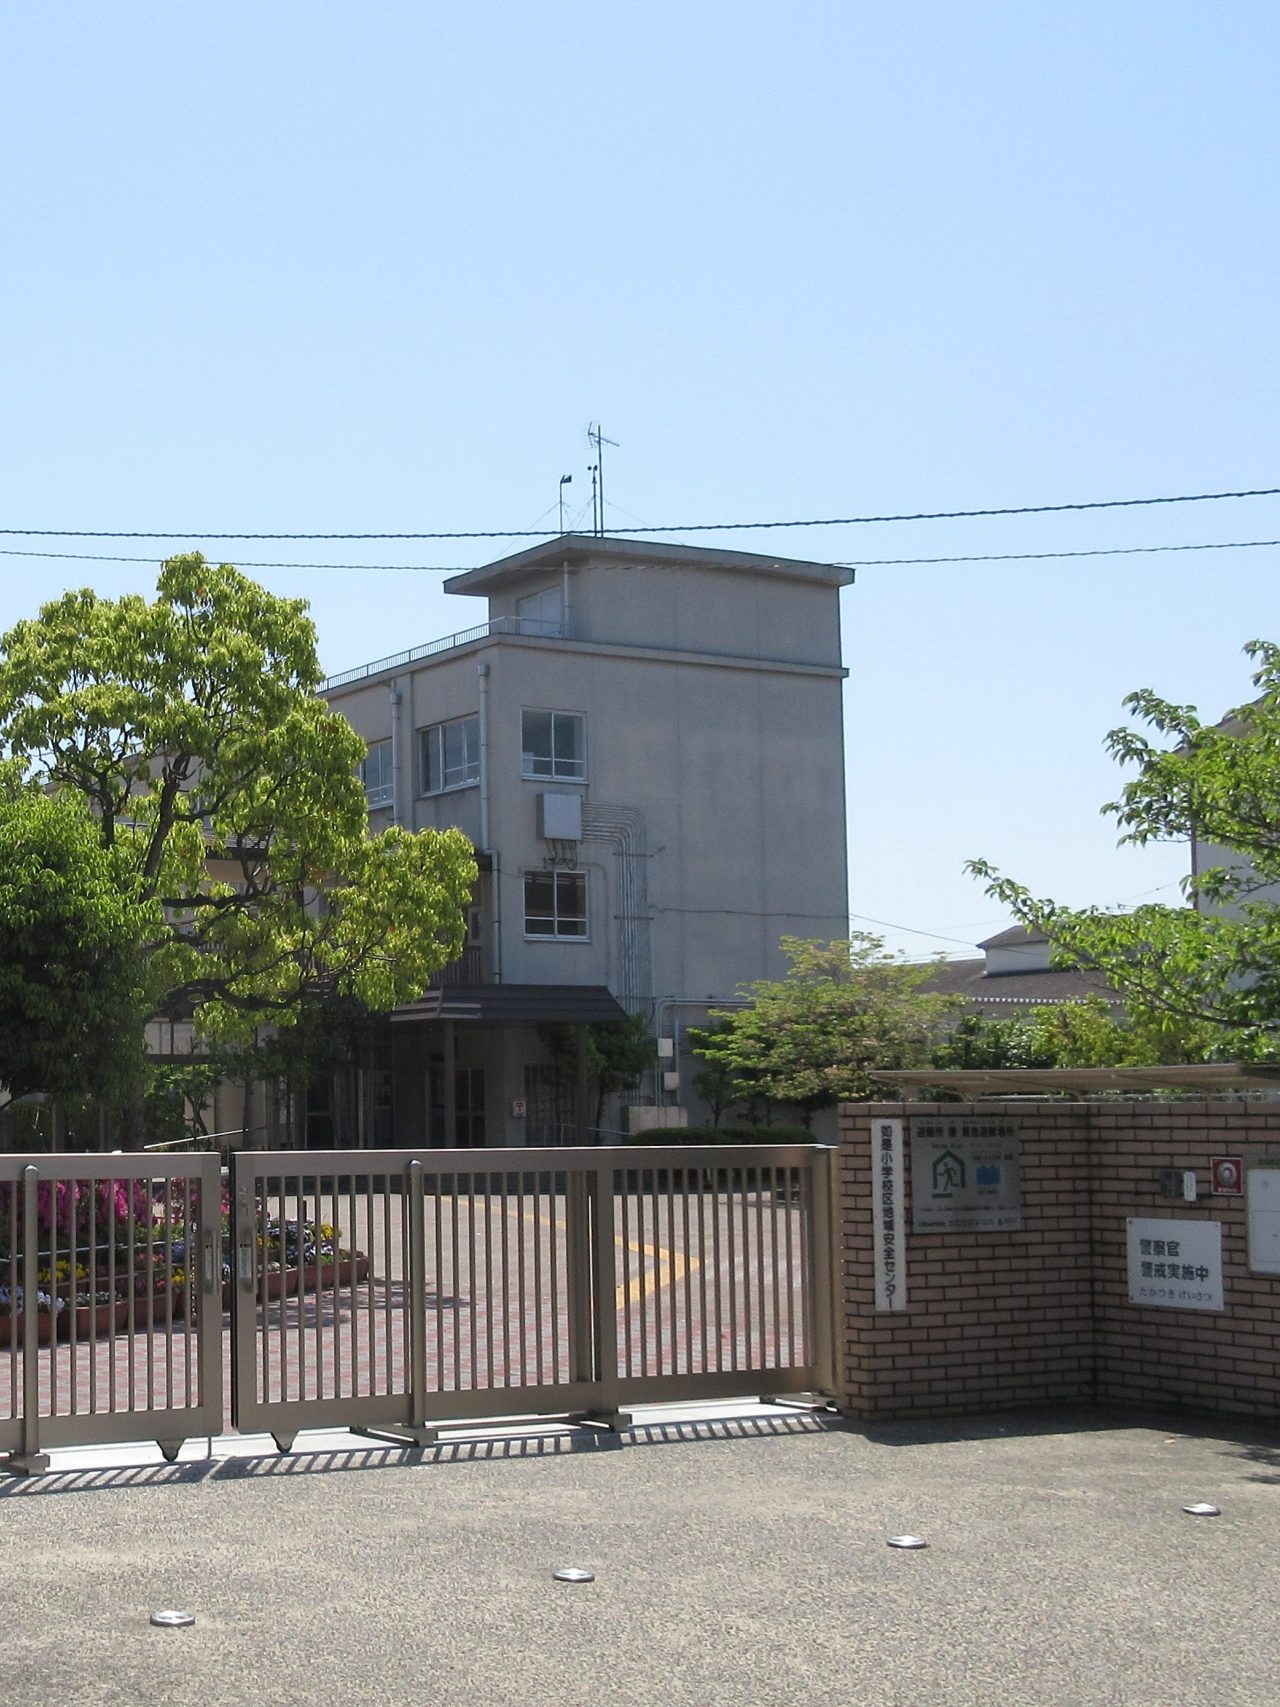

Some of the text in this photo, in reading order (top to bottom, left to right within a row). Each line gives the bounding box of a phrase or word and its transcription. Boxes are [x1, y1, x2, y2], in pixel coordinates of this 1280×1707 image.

[1139, 1238, 1180, 1257] 警察官
[1140, 1261, 1210, 1282] 警戒実施中
[1139, 1286, 1213, 1301] たかつき けいさつ
